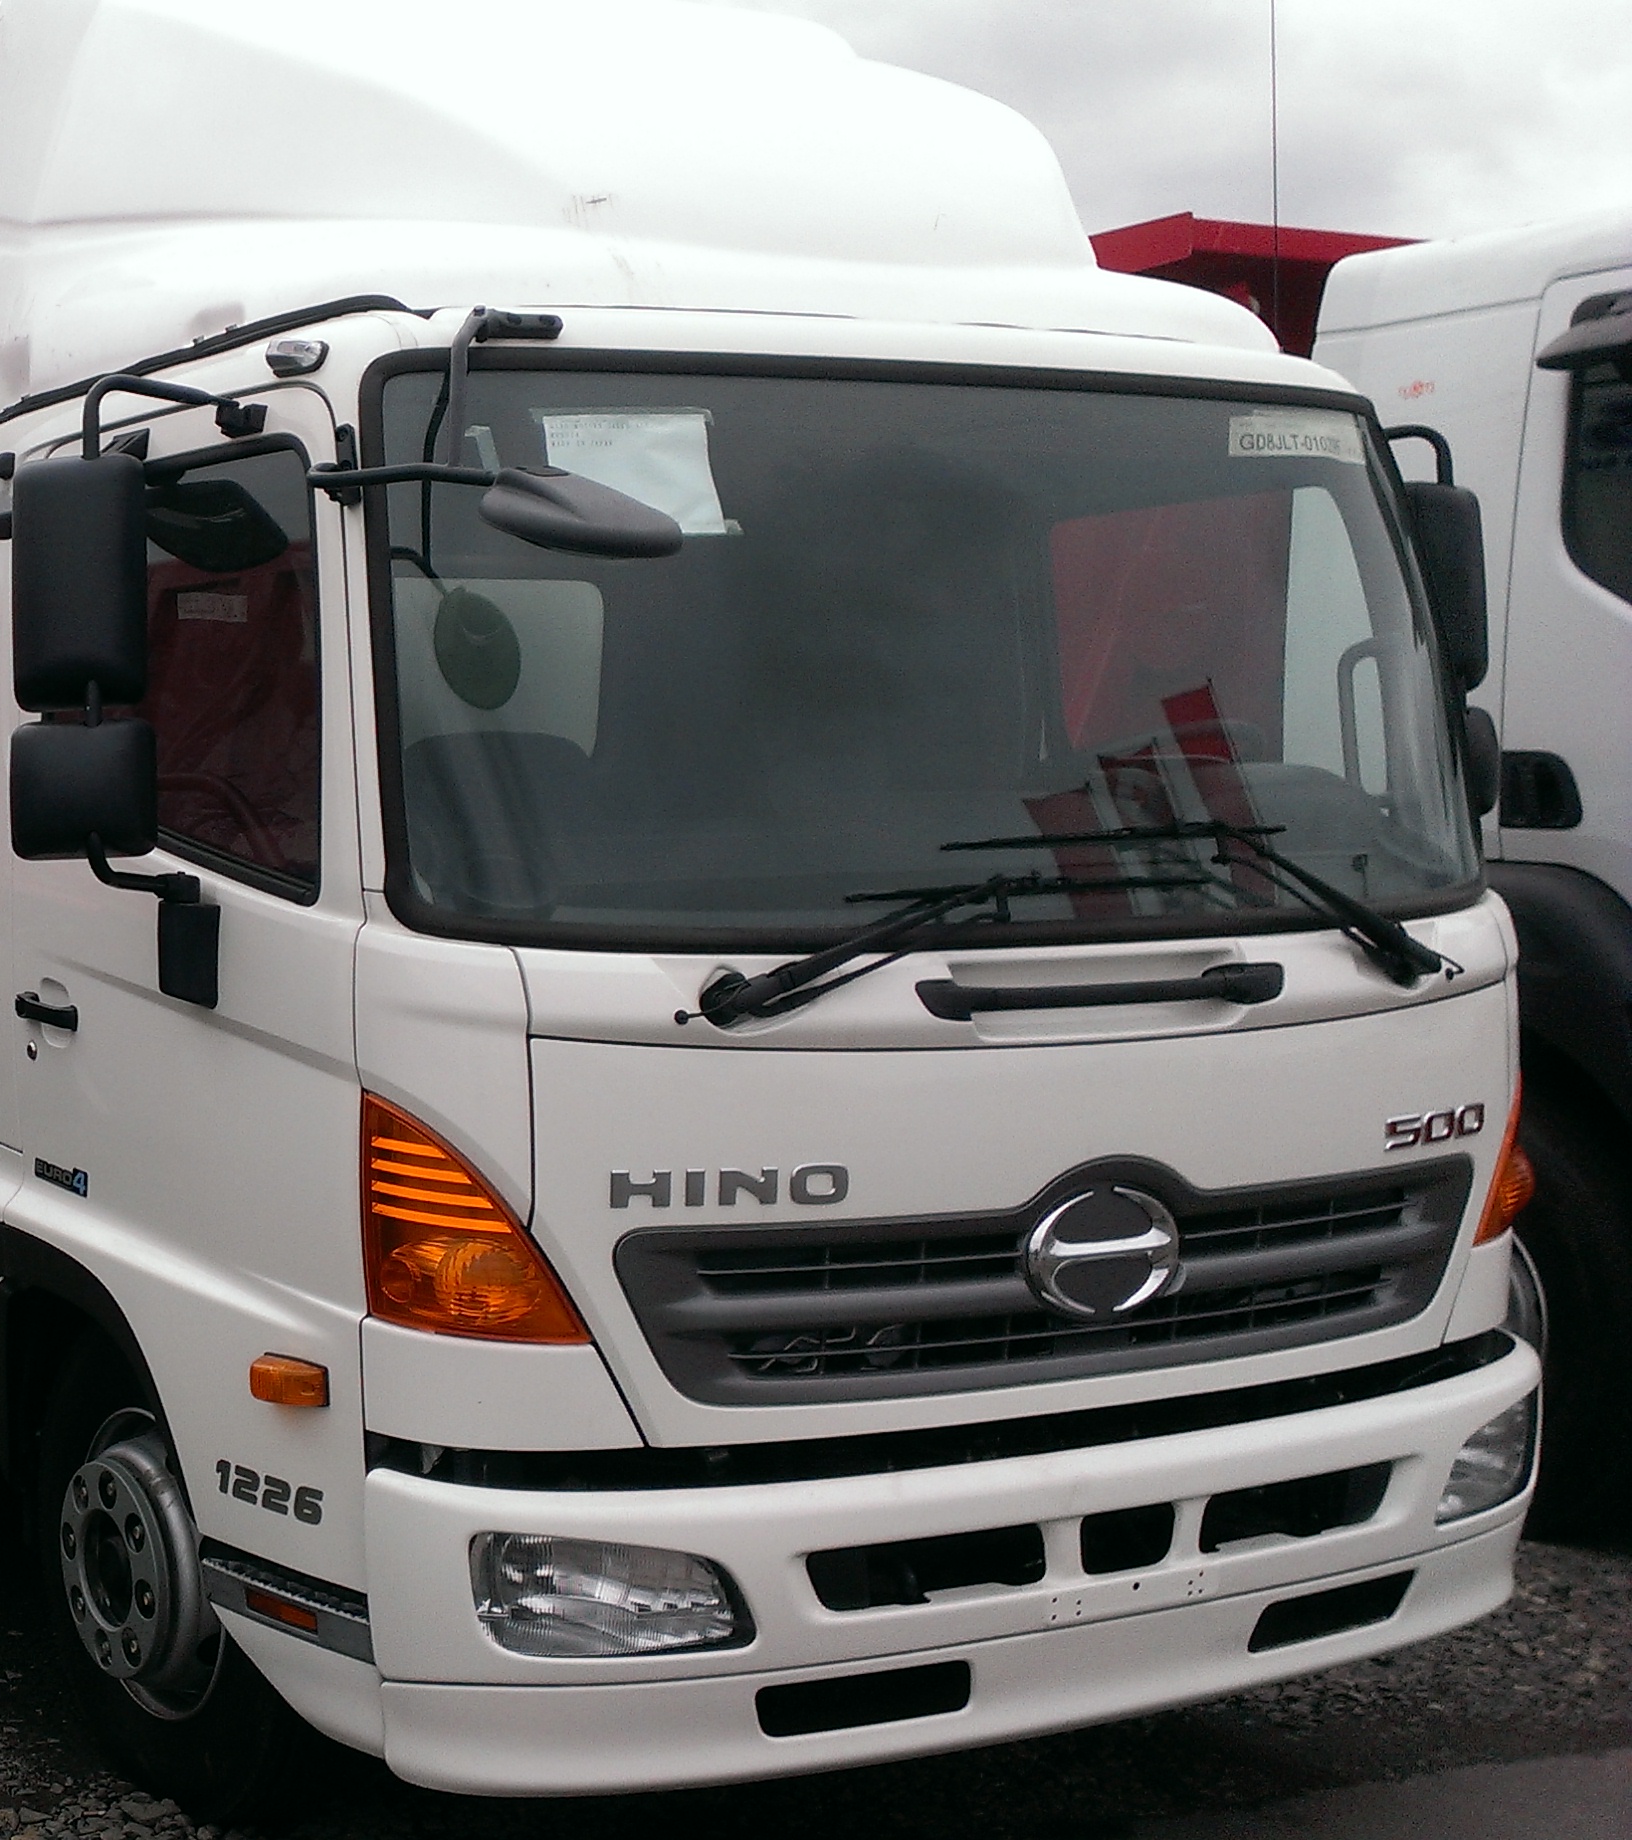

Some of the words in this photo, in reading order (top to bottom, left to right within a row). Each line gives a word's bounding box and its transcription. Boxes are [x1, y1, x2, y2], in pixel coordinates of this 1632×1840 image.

[1384, 1103, 1485, 1151] 500
[610, 1162, 850, 1208] HINO
[215, 1459, 325, 1526] 1226
